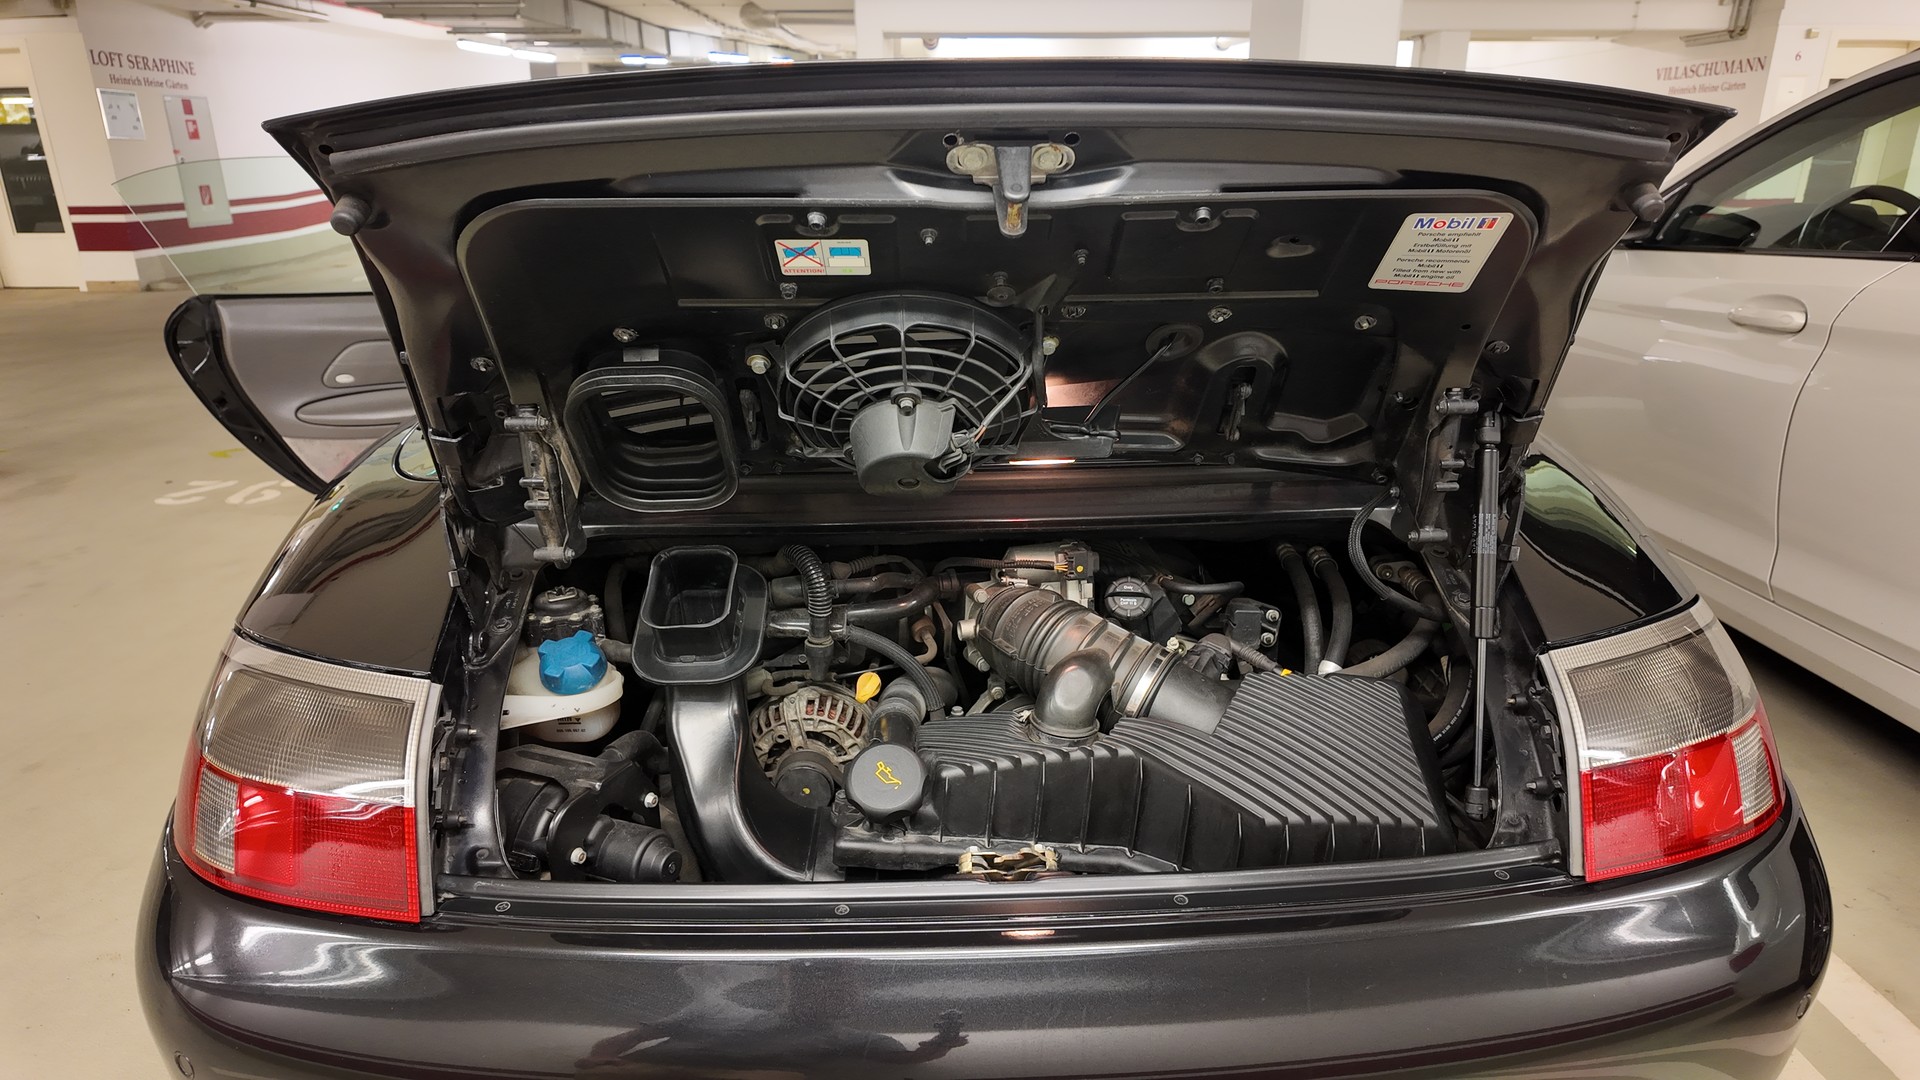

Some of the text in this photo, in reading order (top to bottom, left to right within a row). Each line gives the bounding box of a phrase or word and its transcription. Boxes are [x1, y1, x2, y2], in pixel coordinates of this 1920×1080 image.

[1795, 51, 1802, 61] 6
[90, 49, 196, 76] LOFT SERAPHINE
[109, 74, 142, 86] Heinrich
[143, 77, 164, 88] Heine
[1668, 85, 1697, 95] Heinrich
[1697, 83, 1720, 93] Heine
[1413, 217, 1476, 229] Mobil
[1374, 279, 1464, 287] PORSCHE
